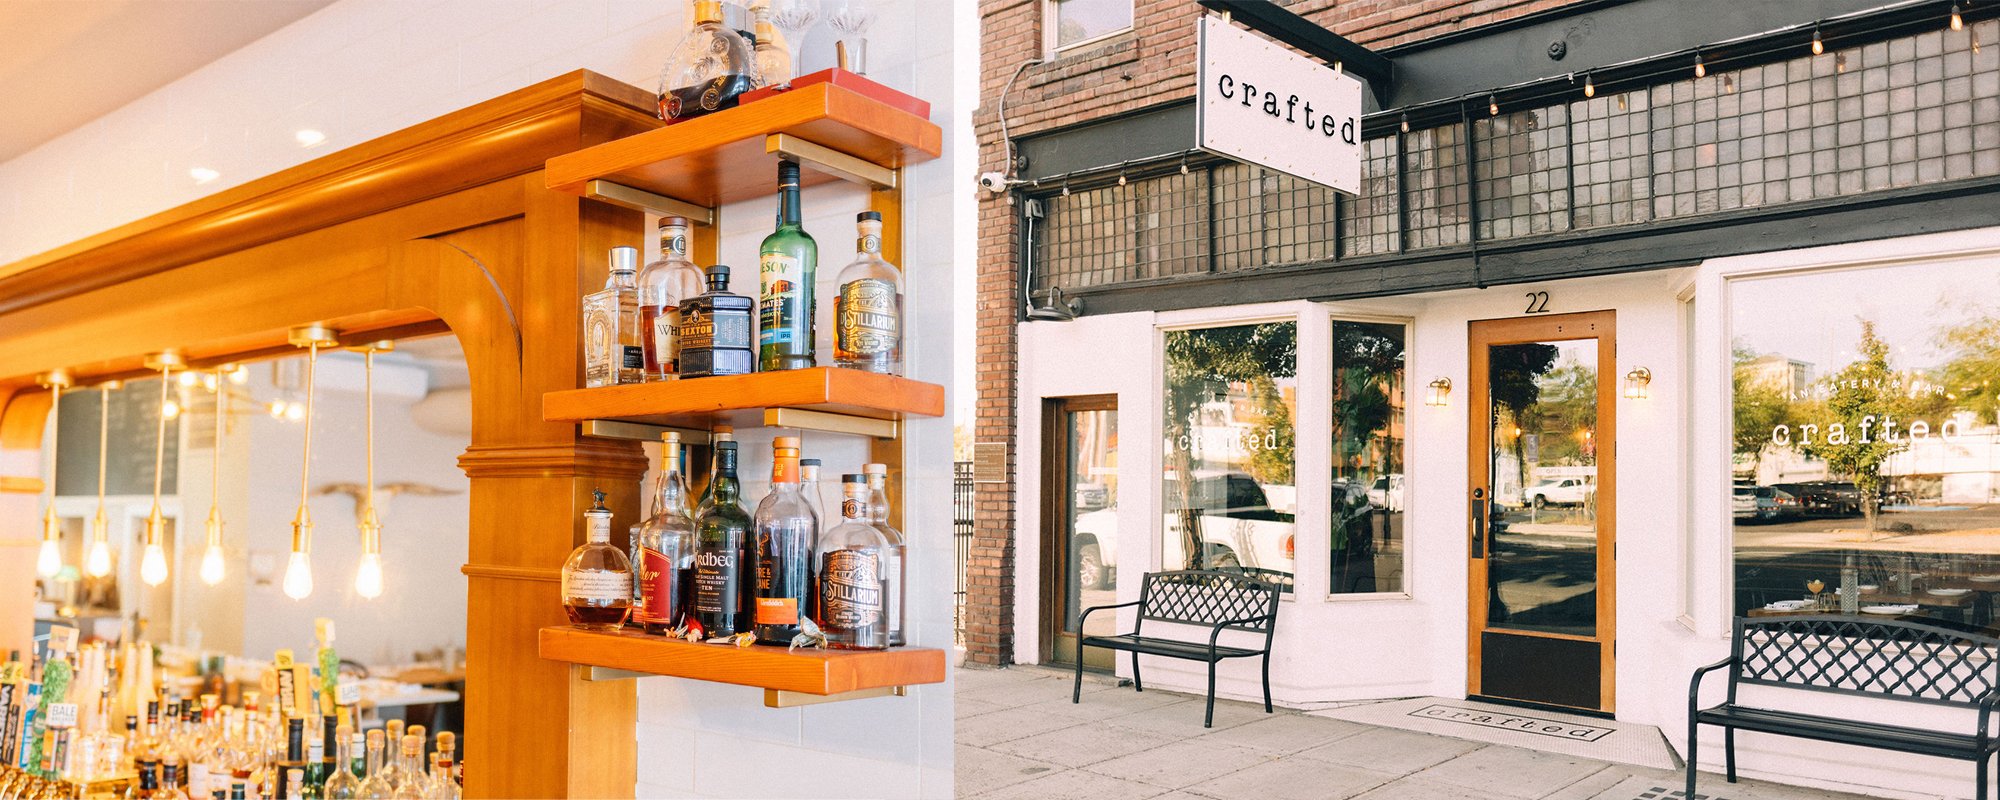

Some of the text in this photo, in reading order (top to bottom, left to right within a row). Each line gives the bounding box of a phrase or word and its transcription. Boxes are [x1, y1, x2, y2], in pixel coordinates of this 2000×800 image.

[1219, 74, 1356, 146] crafted
[1525, 291, 1550, 314] 22
[658, 324, 680, 336] WHI
[680, 325, 712, 336] SEXTON
[1790, 389, 1809, 401] AN
[1819, 378, 1881, 394] EATERY
[1911, 381, 1945, 396] BAR
[1772, 414, 1962, 446] crafted
[1427, 709, 1594, 738] crafted
